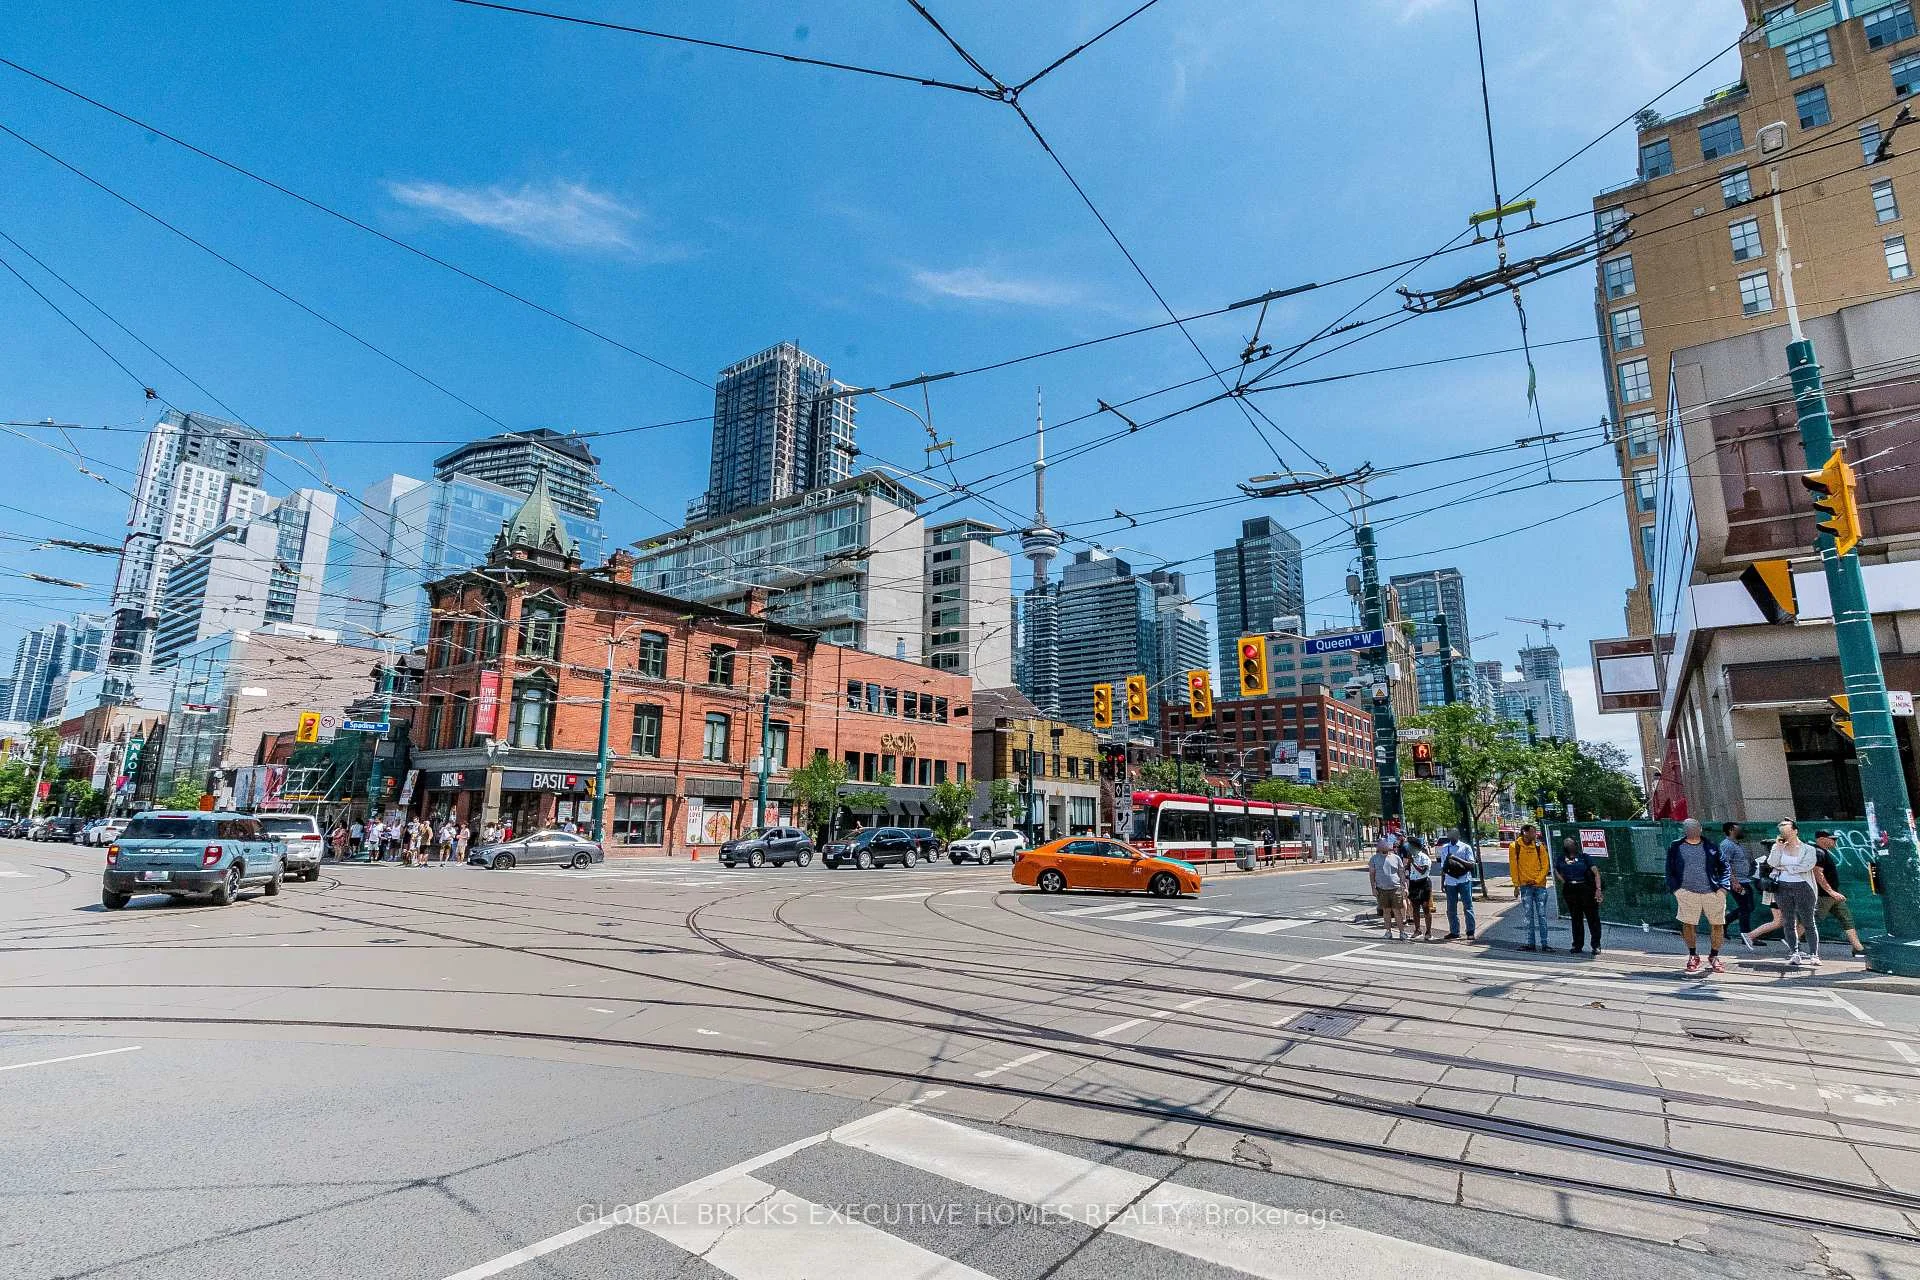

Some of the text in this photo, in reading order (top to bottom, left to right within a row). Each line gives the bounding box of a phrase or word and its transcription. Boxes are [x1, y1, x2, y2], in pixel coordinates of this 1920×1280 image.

[1316, 638, 1352, 651] Queen
[1361, 633, 1372, 644] W
[349, 722, 375, 730] Spadina
[127, 743, 141, 779] NAOT
[440, 772, 461, 787] BASIL
[532, 773, 570, 790] BASIL
[1447, 781, 1456, 791] 4
[1580, 831, 1605, 842] DANGER
